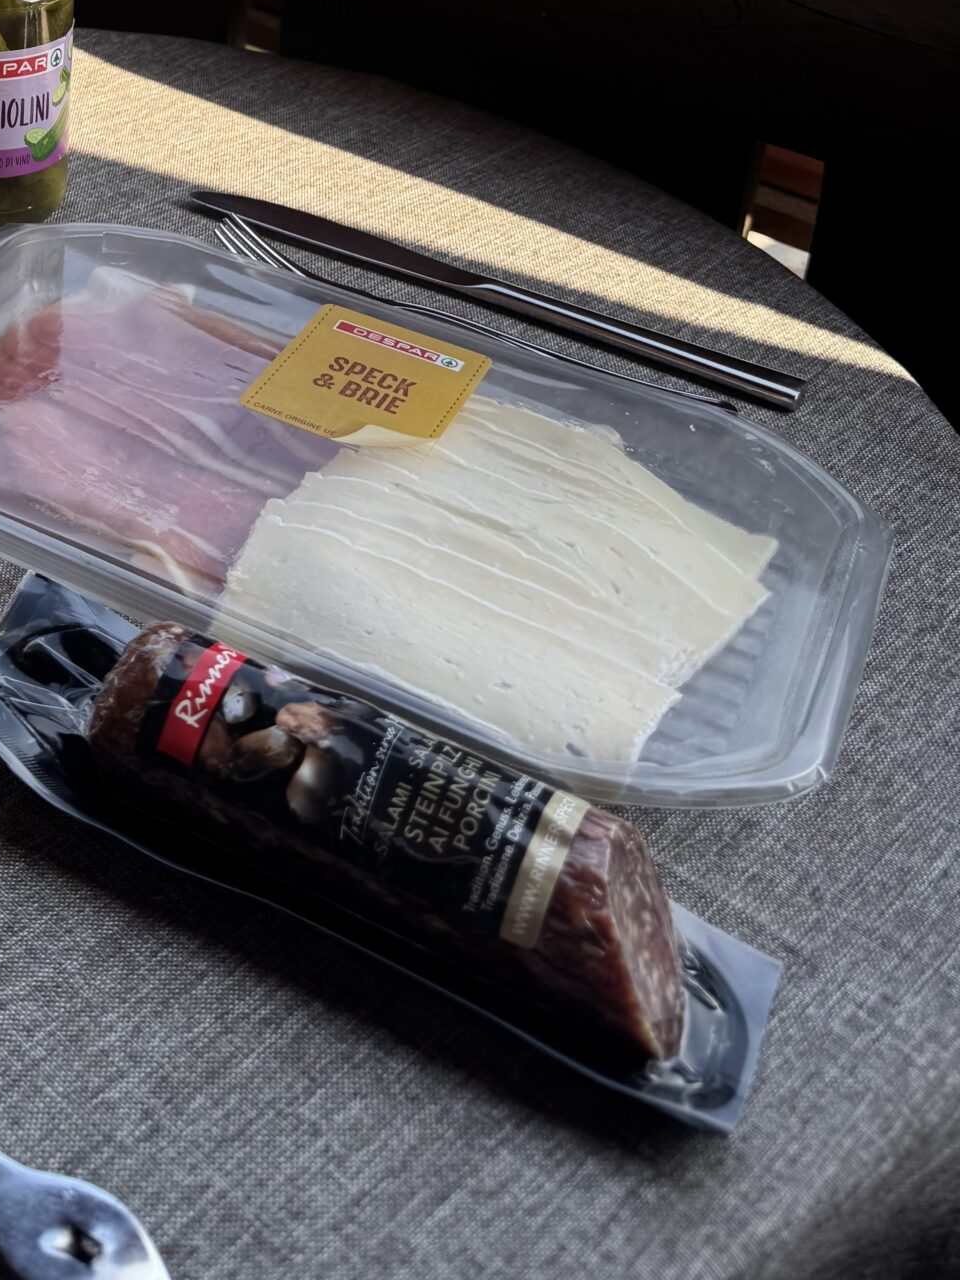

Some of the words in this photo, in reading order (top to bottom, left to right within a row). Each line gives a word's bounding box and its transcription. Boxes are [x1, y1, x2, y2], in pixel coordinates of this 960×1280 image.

[5, 157, 14, 168] DI
[15, 154, 31, 166] VINO
[352, 327, 440, 363] DESPAR
[312, 373, 336, 390] &
[338, 380, 407, 415] BRIE
[328, 356, 419, 397] SPECK
[253, 401, 284, 418] CARNE
[284, 413, 322, 432] ORIGINE
[437, 756, 484, 823] FUNGHI
[373, 781, 414, 857] SALAMI
[452, 770, 502, 851] PORCINI
[428, 825, 450, 854] AI
